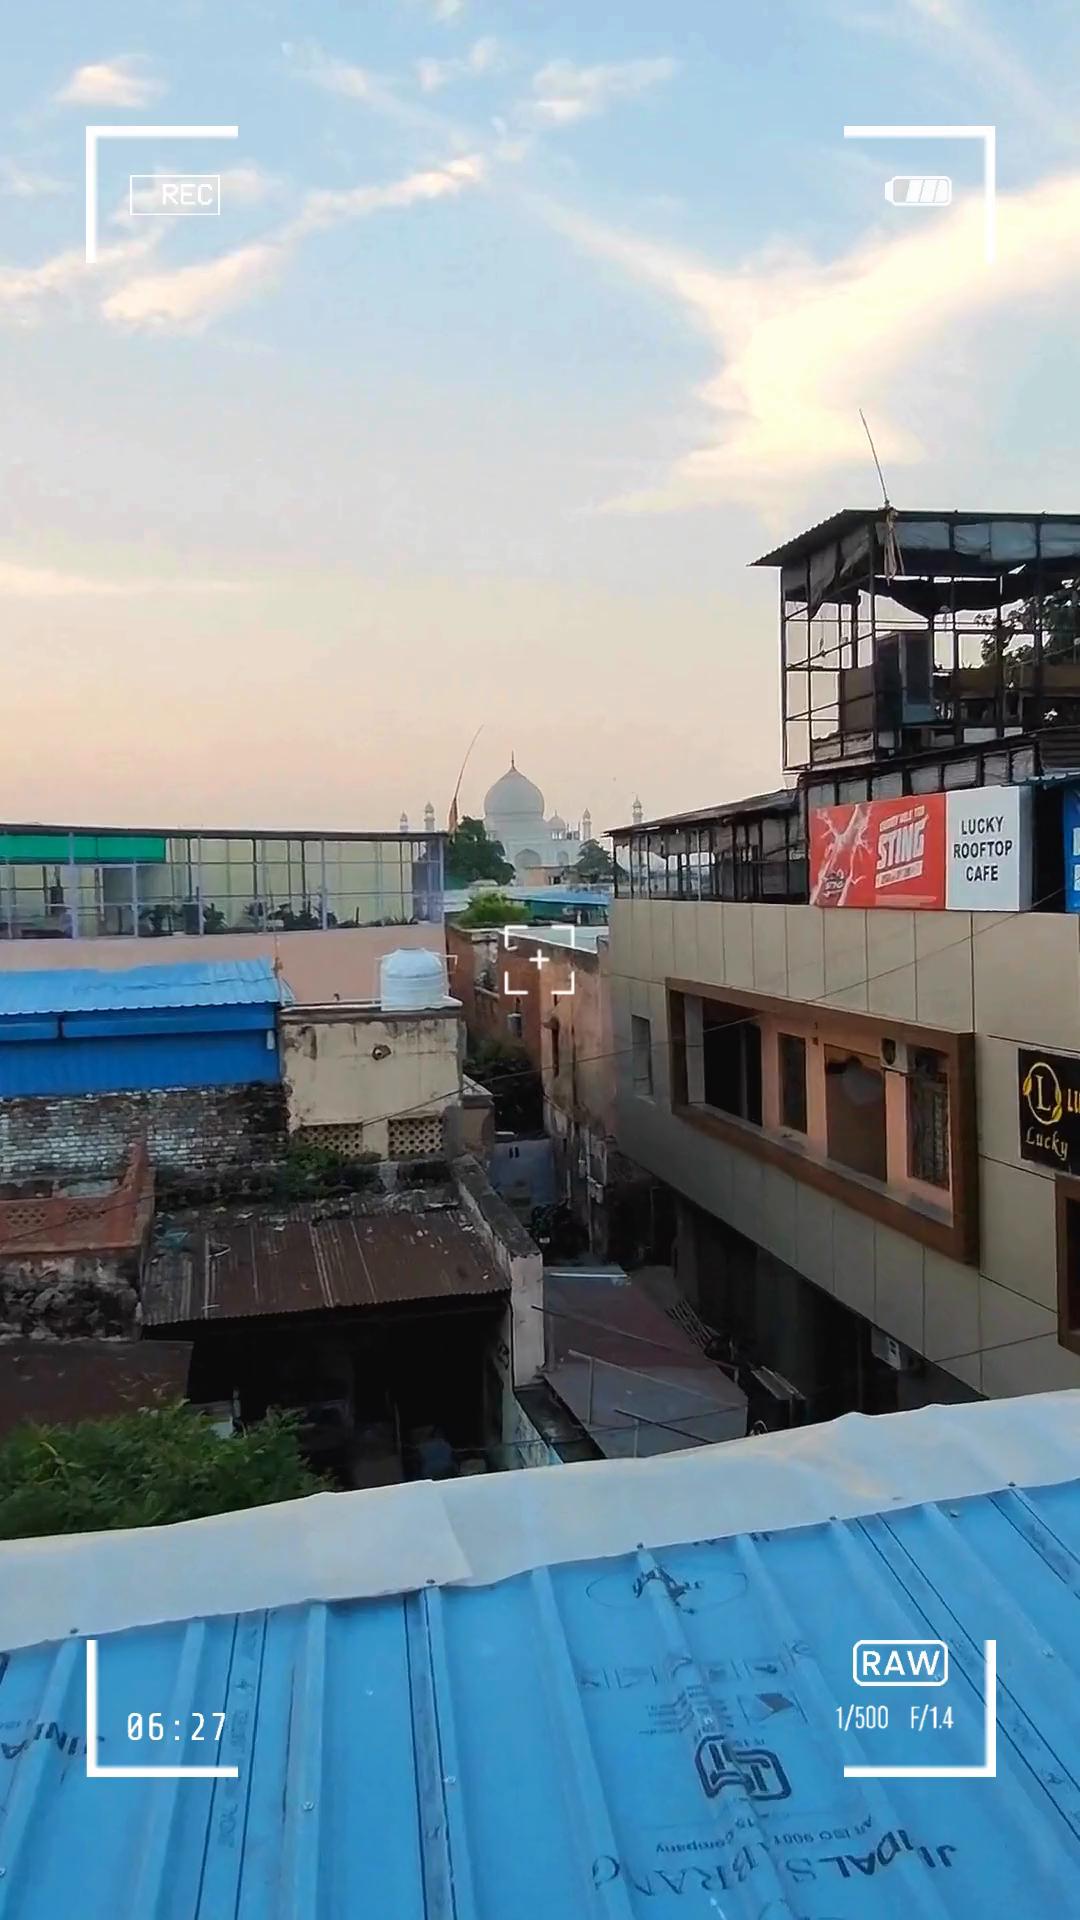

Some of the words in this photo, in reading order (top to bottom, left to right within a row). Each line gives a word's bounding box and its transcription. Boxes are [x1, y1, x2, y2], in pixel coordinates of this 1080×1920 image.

[961, 816, 1004, 836] LUCKY
[876, 814, 928, 870] STING
[953, 839, 1013, 859] ROOFTOP
[966, 864, 998, 882] CAFE
[1026, 1126, 1068, 1161] Lucky
